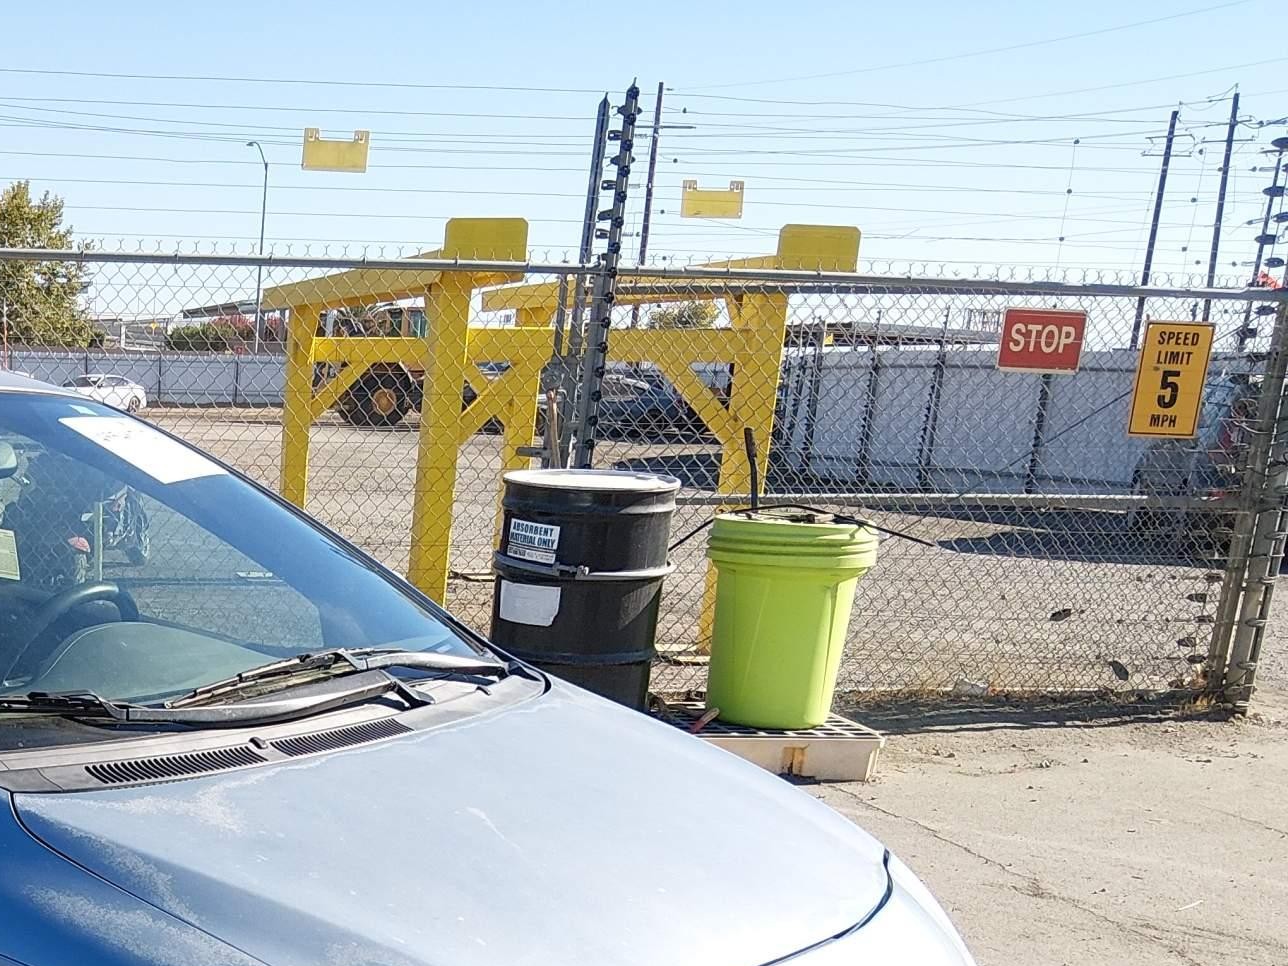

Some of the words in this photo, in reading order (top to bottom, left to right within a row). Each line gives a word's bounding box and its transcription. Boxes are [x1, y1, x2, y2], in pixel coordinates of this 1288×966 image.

[1009, 323, 1076, 353] STOP
[1157, 331, 1200, 346] SPEED
[1156, 351, 1194, 365] LIMIT
[1157, 370, 1181, 409] 5
[1149, 414, 1177, 428] MPH
[512, 521, 554, 537] ABSORBENT
[510, 532, 536, 545] MATERIAL
[537, 537, 556, 548] ONLY
